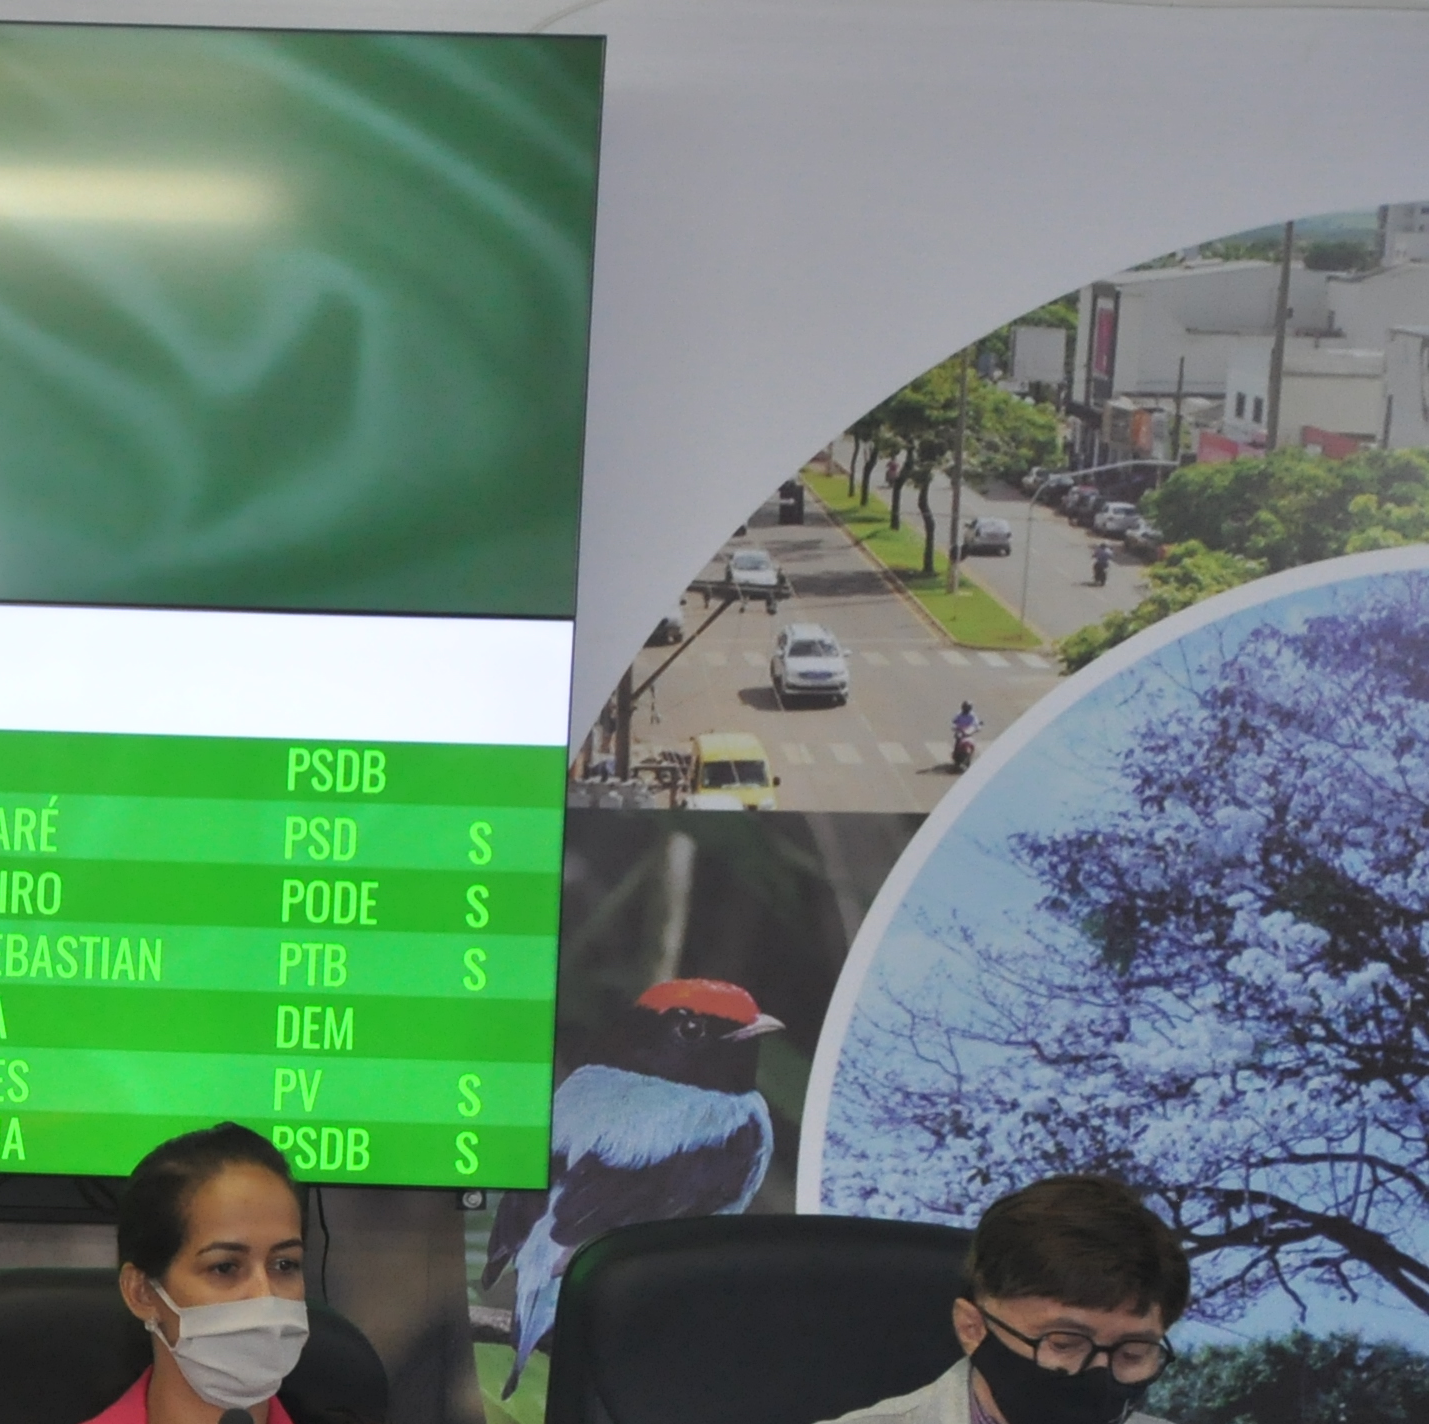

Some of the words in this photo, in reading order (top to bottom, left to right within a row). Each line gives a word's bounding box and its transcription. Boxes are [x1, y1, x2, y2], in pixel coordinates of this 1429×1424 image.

[287, 746, 386, 795] PSDB
[283, 814, 358, 860] PSD
[469, 820, 494, 867] S
[280, 879, 379, 927] PODE
[465, 884, 490, 930] S
[279, 941, 348, 989] PTB
[462, 947, 488, 993] S
[276, 1006, 354, 1053] DEM
[273, 1068, 323, 1115] PV
[457, 1074, 482, 1118] S
[272, 1125, 370, 1172] PSDB
[455, 1131, 479, 1175] S
